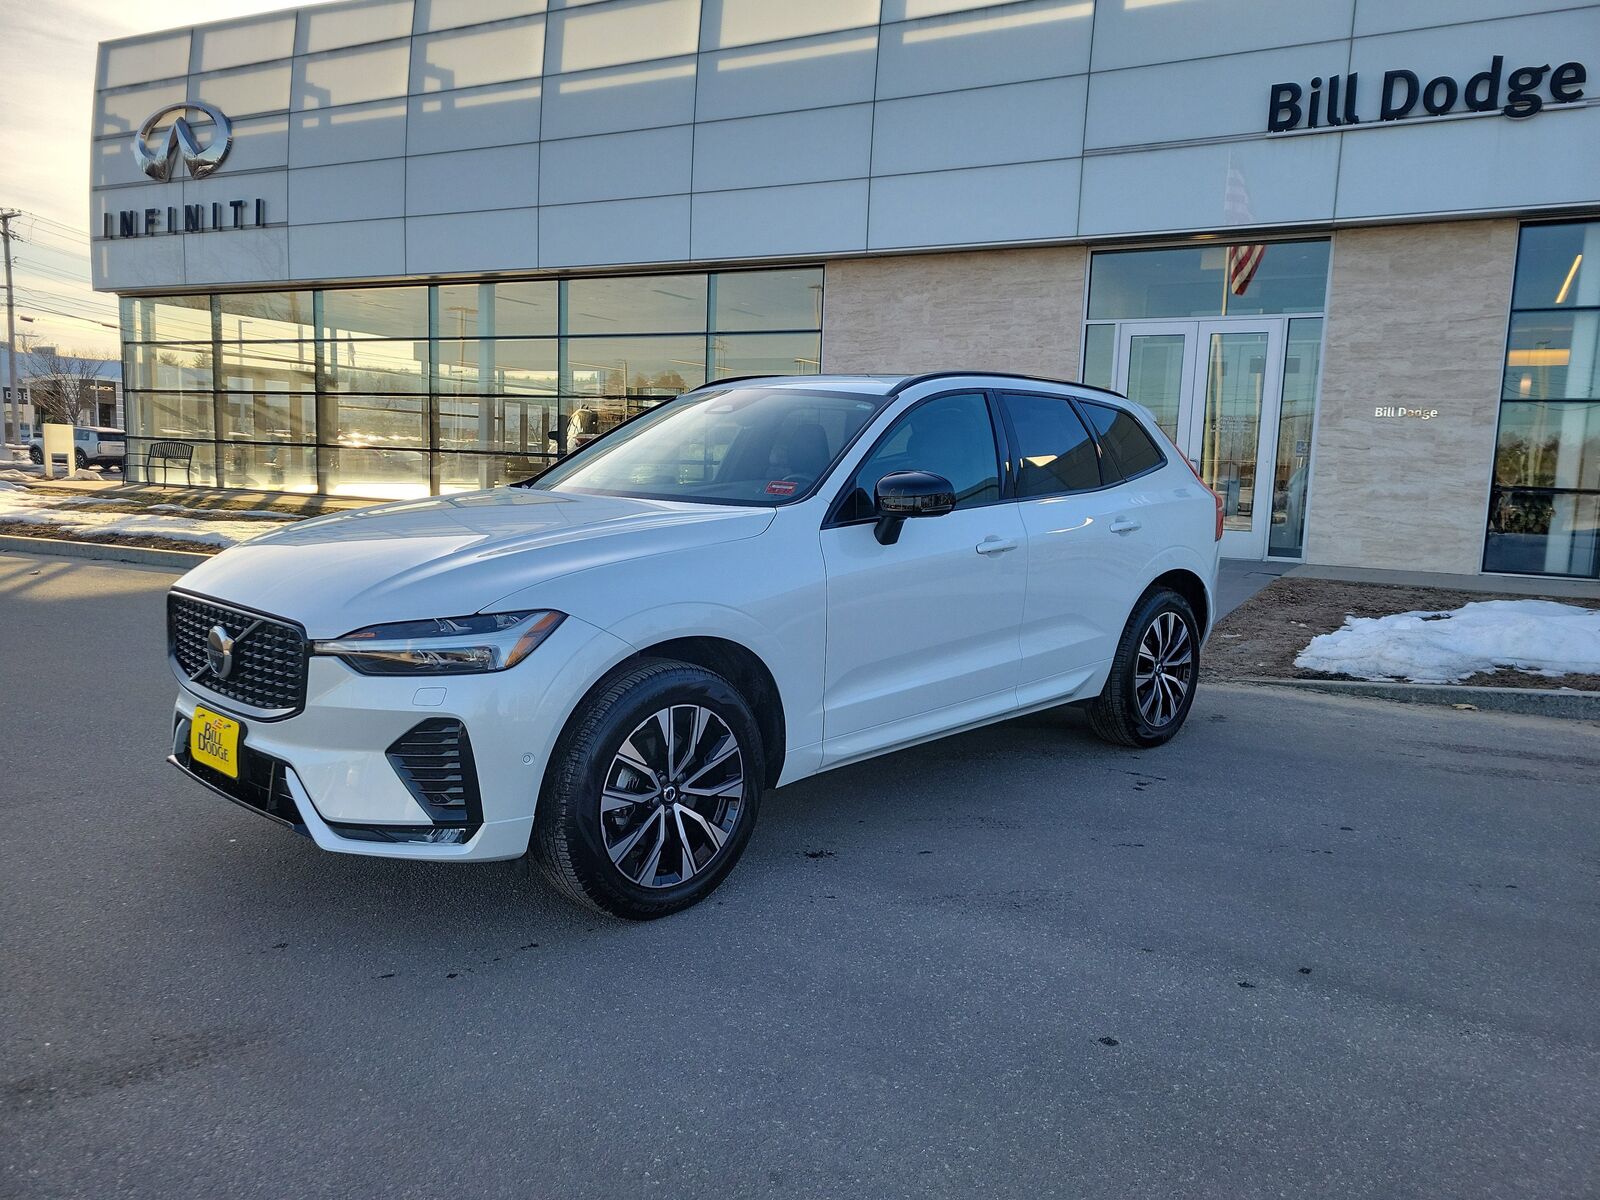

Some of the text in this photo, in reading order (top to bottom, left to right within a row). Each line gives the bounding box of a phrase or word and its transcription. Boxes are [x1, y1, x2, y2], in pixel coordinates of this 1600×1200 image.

[1267, 54, 1587, 133] Bill Dodge
[103, 198, 266, 239] INFINITI
[1374, 406, 1439, 420] Bill Dodge
[198, 733, 229, 762] DODGE
[204, 722, 222, 746] BILL
